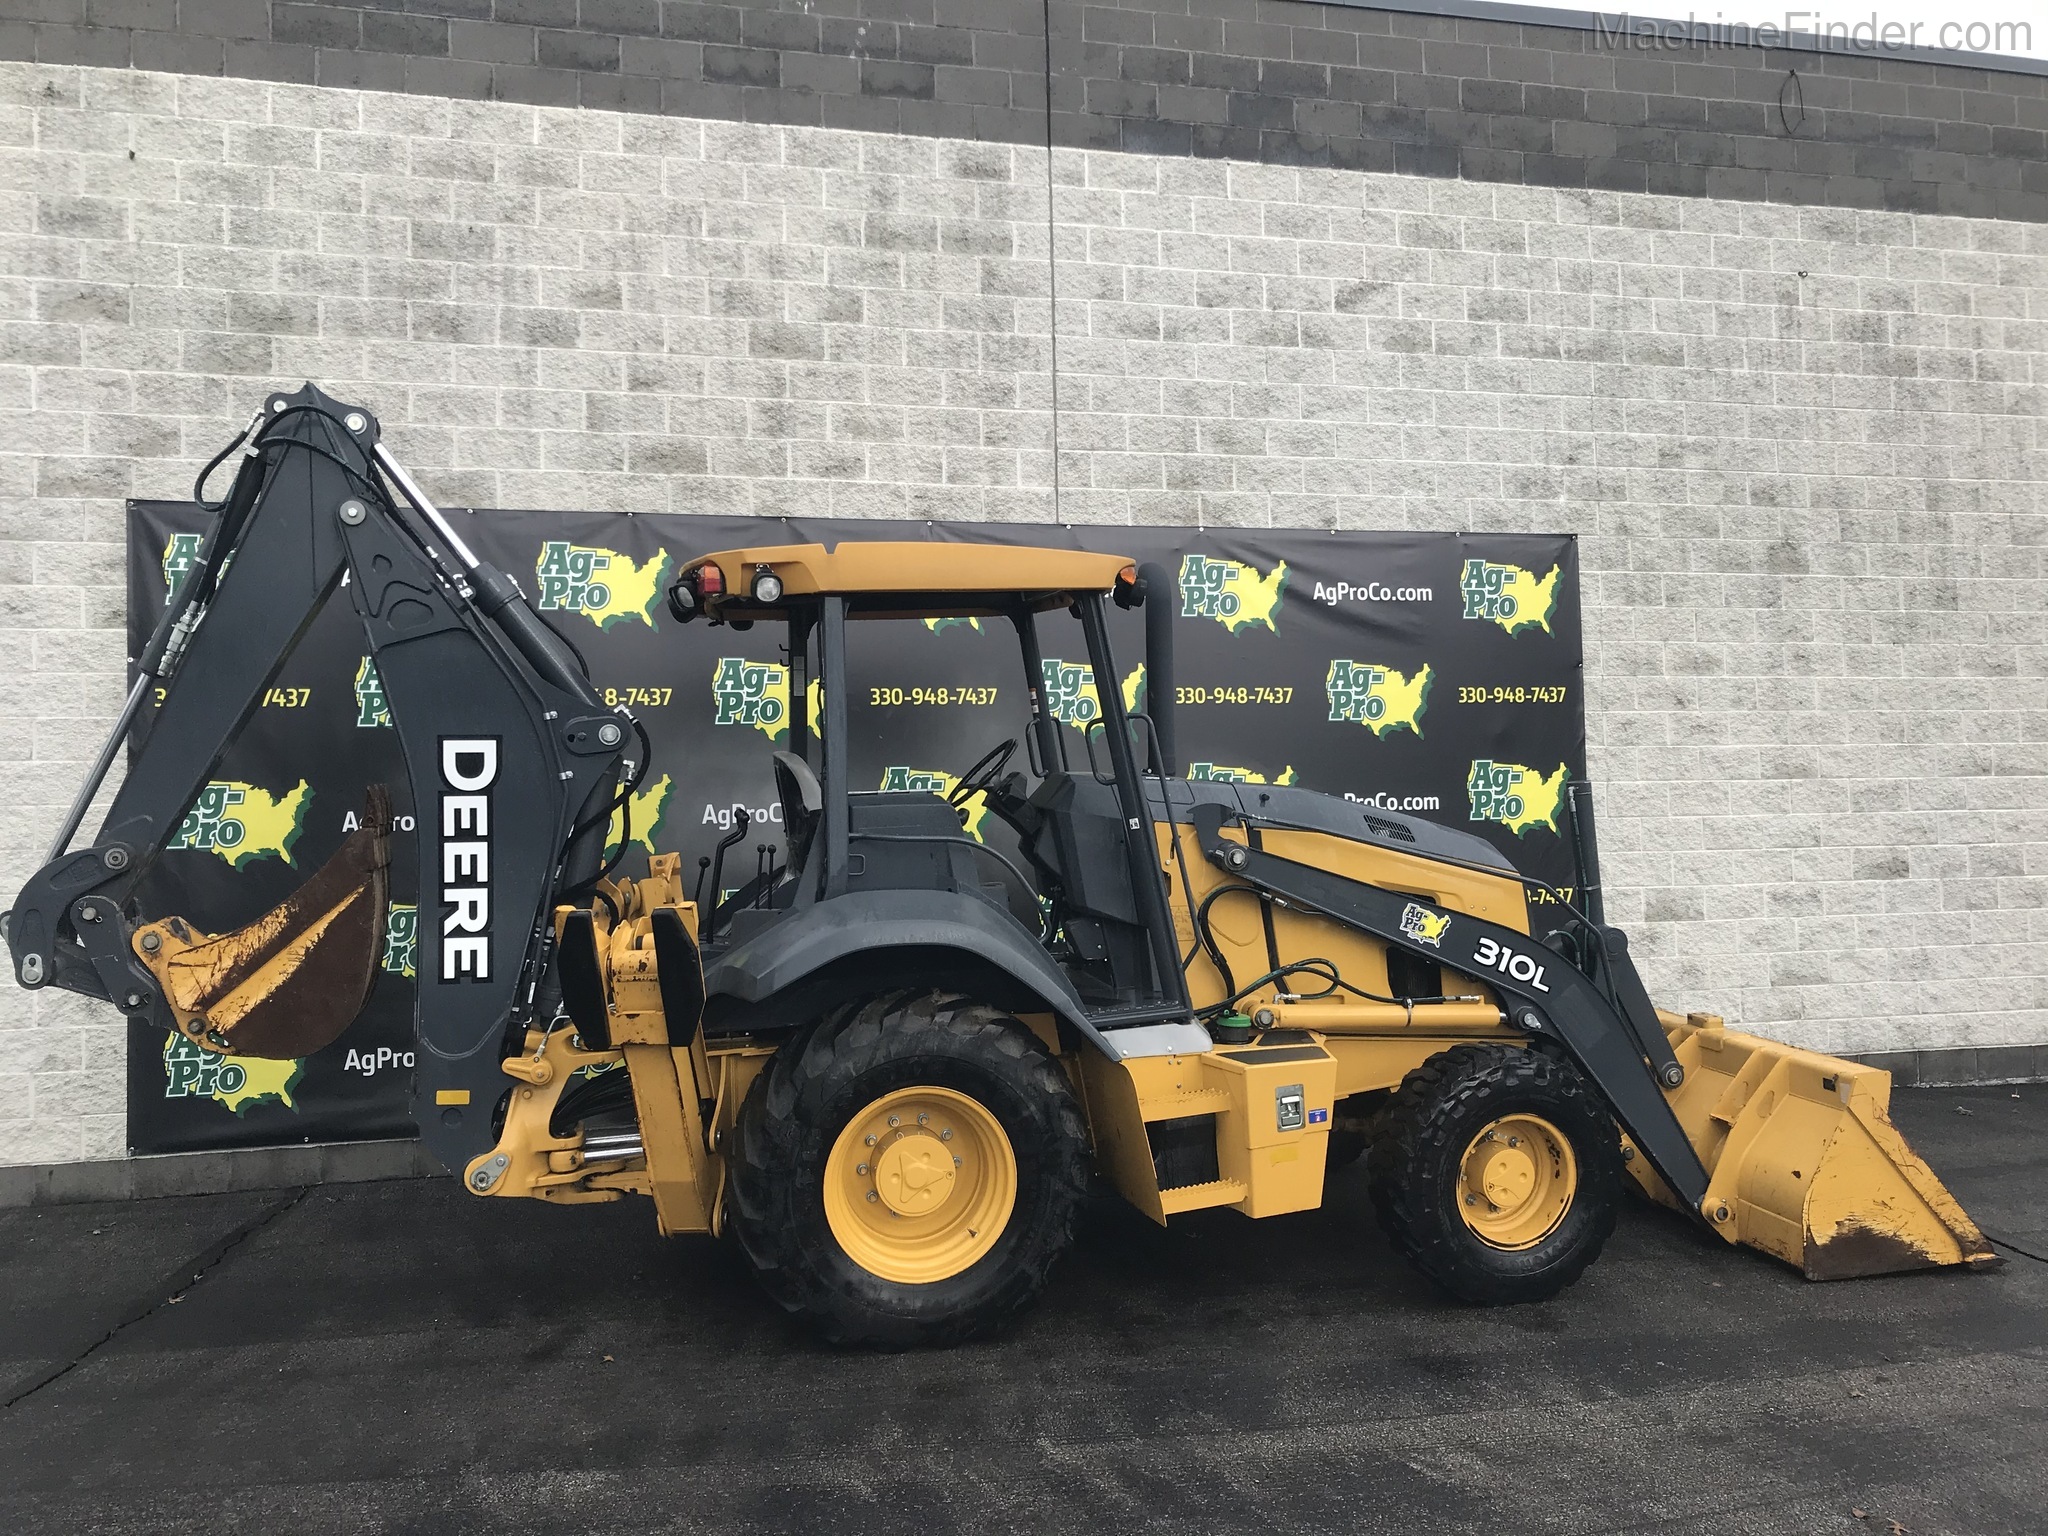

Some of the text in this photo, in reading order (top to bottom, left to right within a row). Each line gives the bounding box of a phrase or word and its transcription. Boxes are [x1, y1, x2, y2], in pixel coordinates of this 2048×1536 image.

[539, 541, 610, 583] Ag-
[1181, 554, 1239, 592] Ag-
[1463, 559, 1517, 595] Ag-
[539, 576, 611, 610] Pro
[1181, 586, 1240, 616] Pro
[1313, 582, 1433, 606] AgProCo.com
[1463, 588, 1518, 619] Pro
[715, 657, 782, 694] Ag-
[1042, 658, 1096, 695] Ag-
[1328, 659, 1385, 697] Ag-
[715, 691, 783, 725] Pro
[870, 687, 998, 706] 330-948-7437
[1175, 687, 1293, 704] 330-948-7437
[1328, 690, 1386, 720] Pro
[1458, 687, 1566, 703] 330-948-7437
[1470, 759, 1523, 795] Ag-
[194, 785, 245, 822] g-
[1470, 790, 1524, 821] Pro
[442, 739, 498, 980] DEERE
[1403, 917, 1426, 932] Pro
[1473, 937, 1550, 993] 310L
[166, 1059, 246, 1098] Pro
[344, 1047, 415, 1076] AgPro
